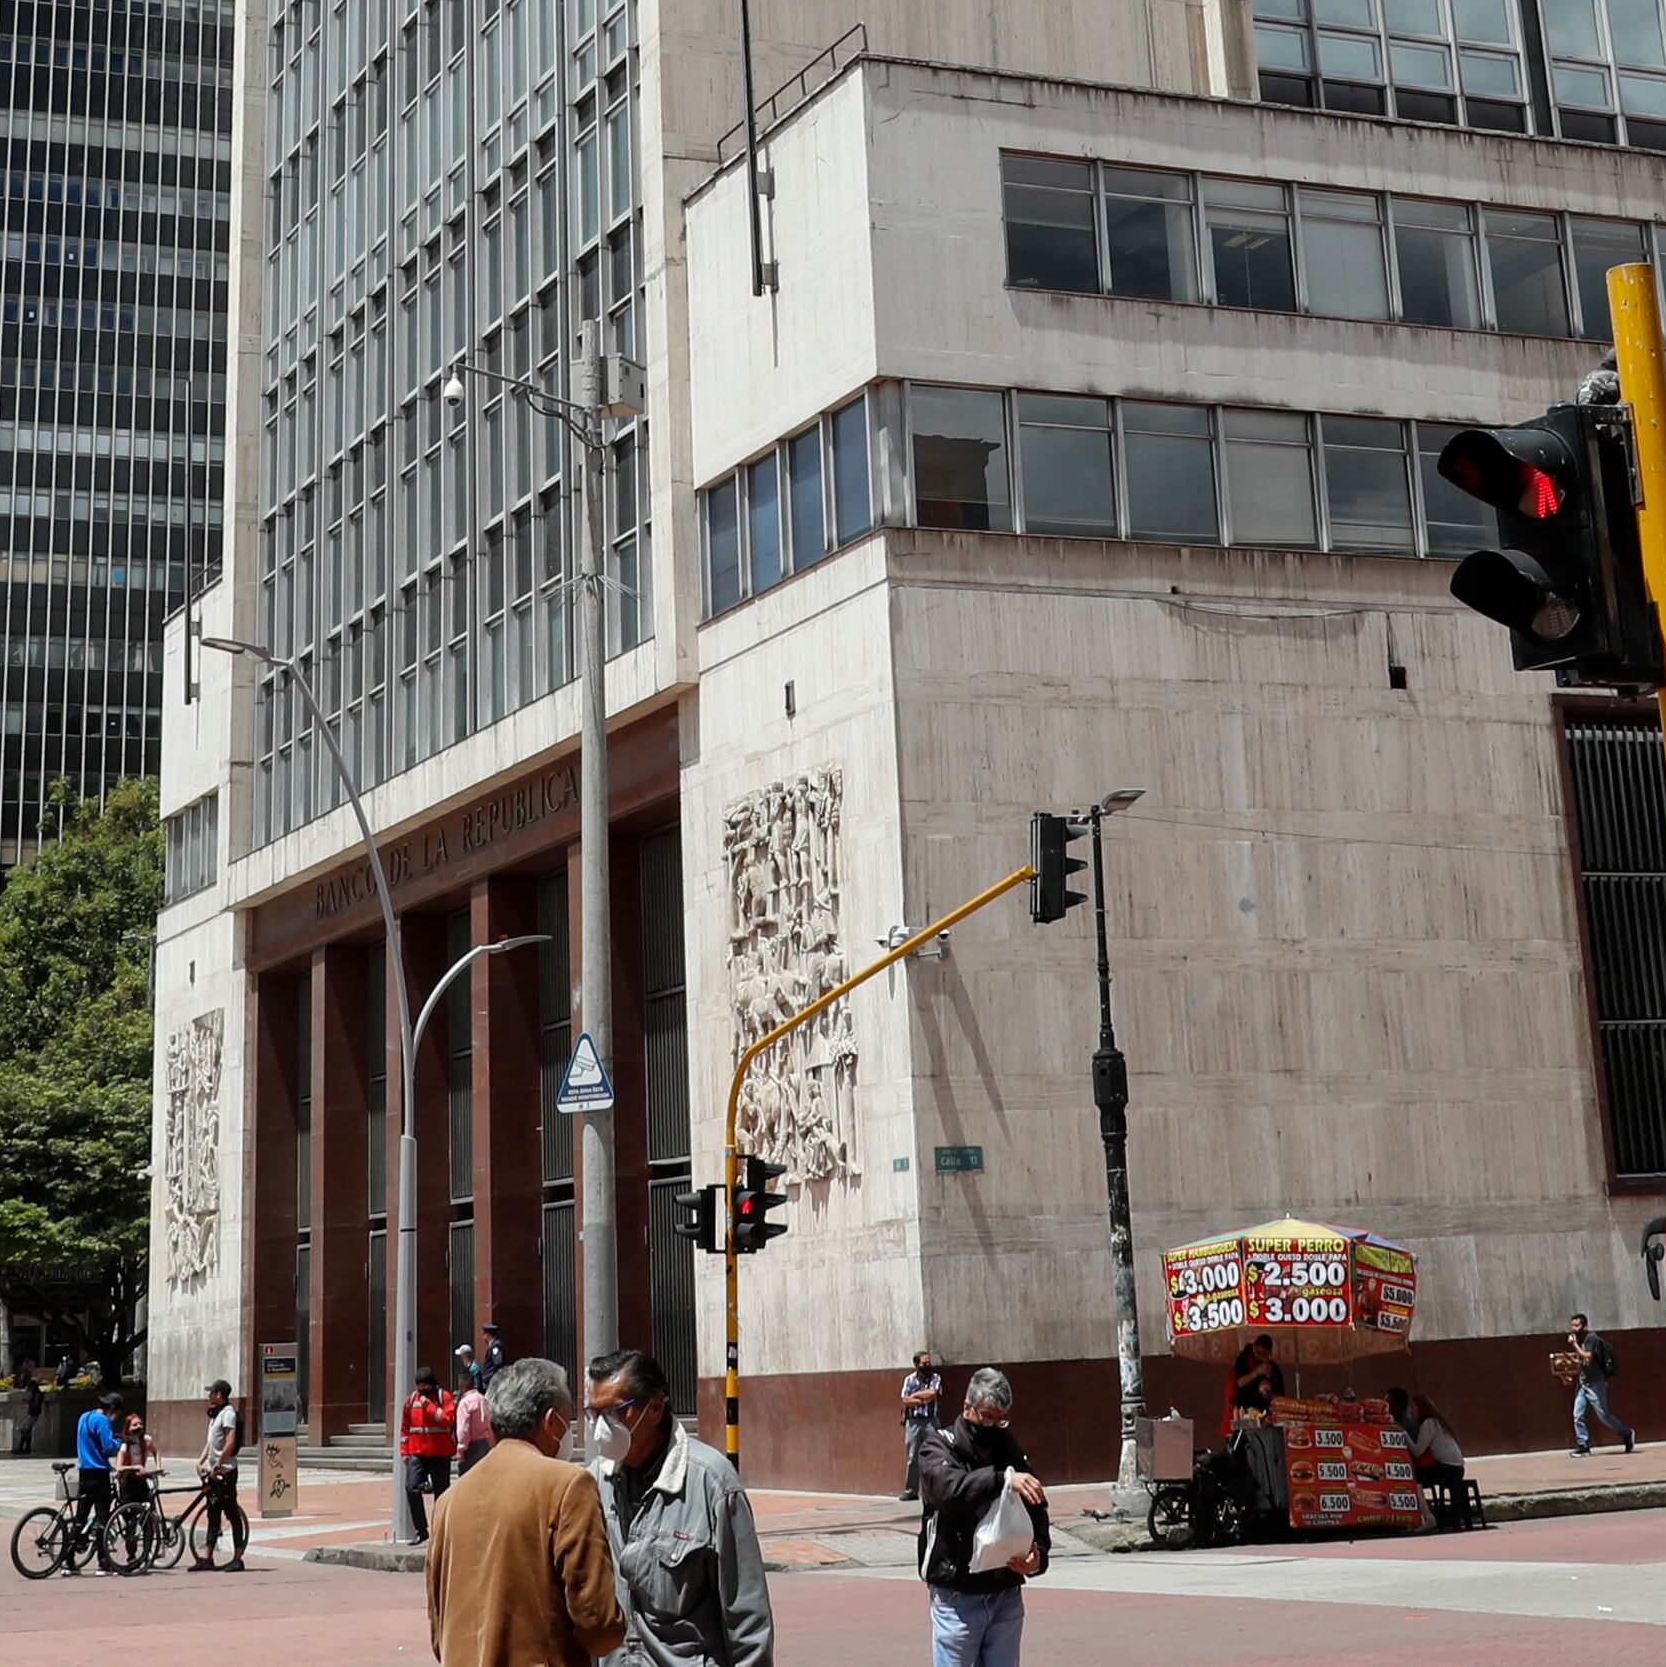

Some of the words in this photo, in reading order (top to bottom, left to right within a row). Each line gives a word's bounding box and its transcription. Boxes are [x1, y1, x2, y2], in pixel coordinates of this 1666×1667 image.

[316, 860, 378, 919] BANCO
[389, 842, 413, 885] DE
[424, 828, 449, 871] LA
[462, 765, 579, 854] REPUBLICA
[940, 1156, 961, 1167] Calle
[1248, 1238, 1291, 1252] SUPER
[1298, 1238, 1344, 1252] PERRO
[1167, 1249, 1188, 1262] SUPER
[1253, 1253, 1275, 1262] DOBLE
[1303, 1253, 1326, 1262] DOBLE
[1328, 1253, 1347, 1262] PAPA
[1185, 1261, 1240, 1295] 3.000
[1264, 1262, 1345, 1286] 2.500
[1213, 1287, 1240, 1303] gaseosa
[1302, 1287, 1344, 1298] gaseosa
[1188, 1298, 1244, 1332] 3.500
[1265, 1297, 1347, 1322] 3.000
[1317, 1432, 1343, 1445] 3.500
[1382, 1434, 1407, 1446] 3.000
[1319, 1465, 1345, 1477] 5.500
[1387, 1465, 1412, 1477] 4.500
[1321, 1496, 1348, 1509] 6.500
[1391, 1495, 1416, 1508] 5.500
